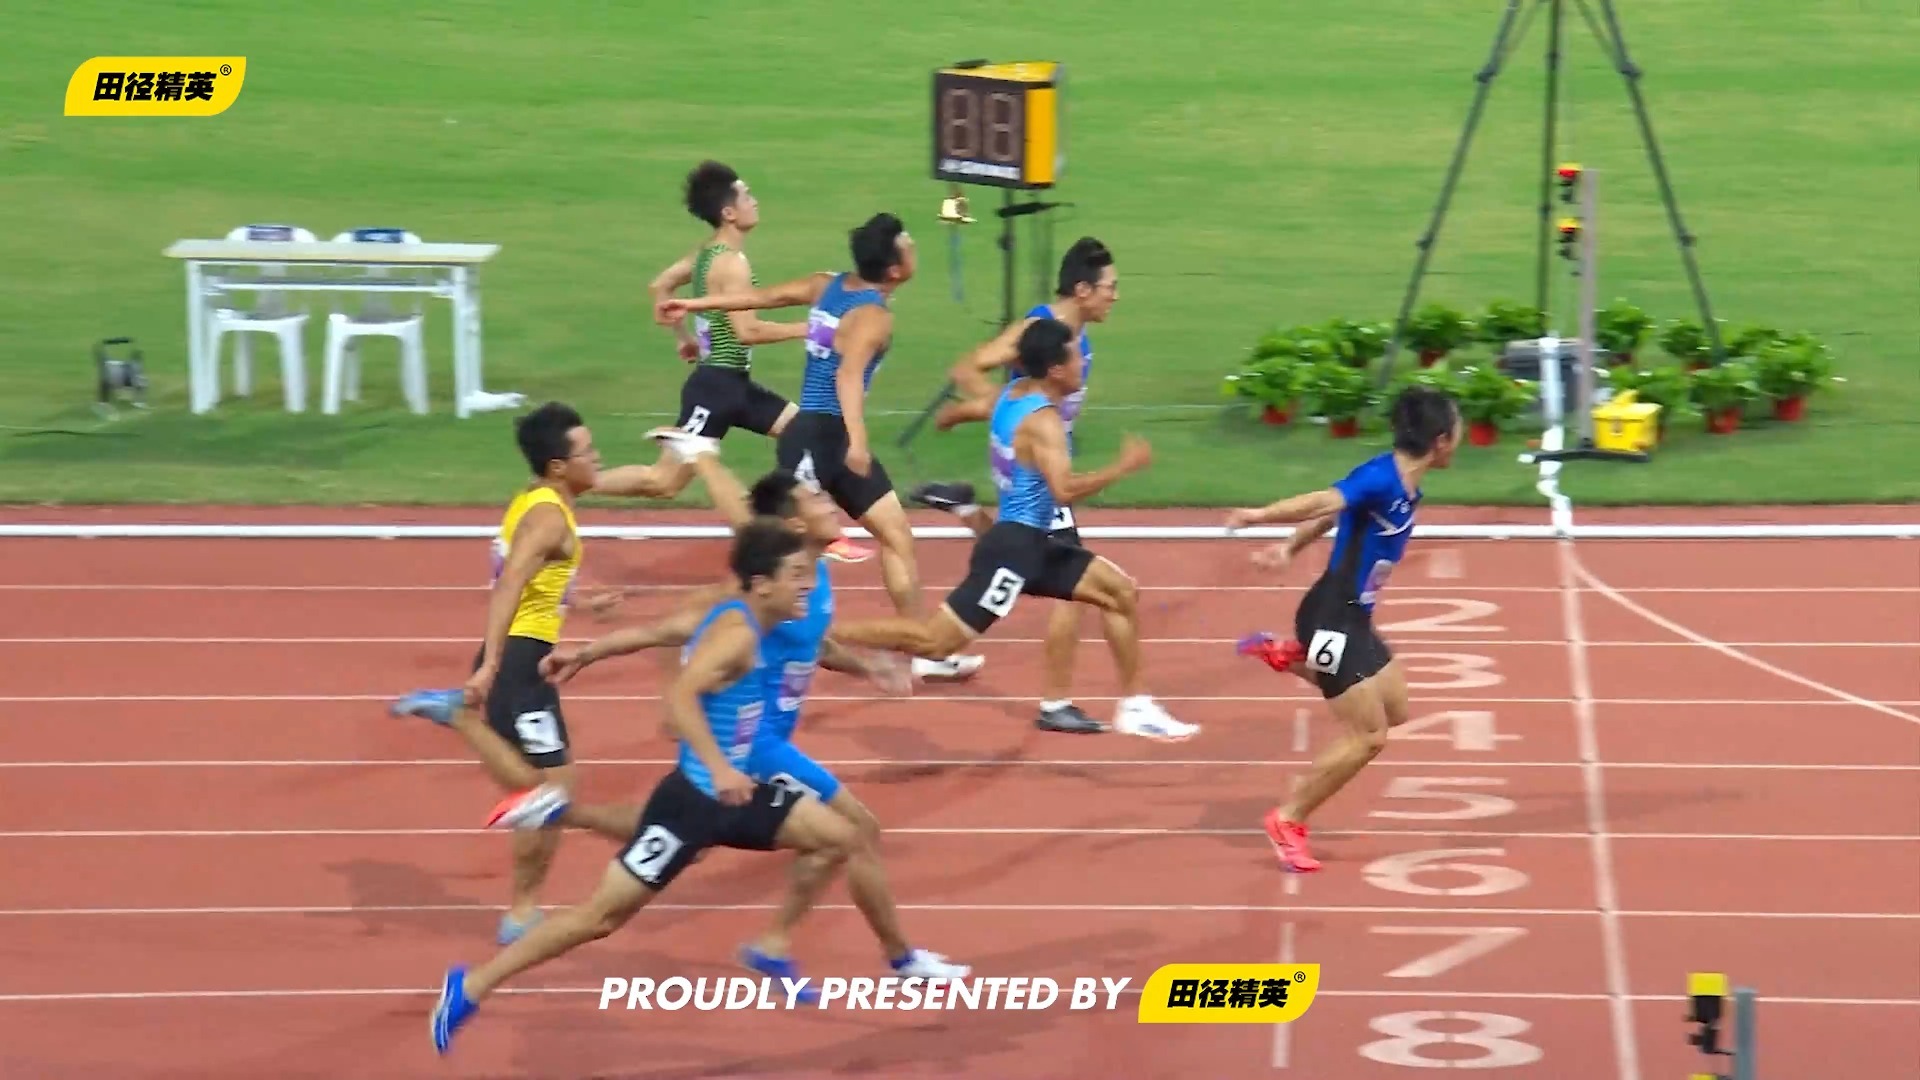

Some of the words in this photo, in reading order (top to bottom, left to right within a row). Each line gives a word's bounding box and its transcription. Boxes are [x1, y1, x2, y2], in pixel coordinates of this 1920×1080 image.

[990, 576, 1018, 606] 5
[1377, 598, 1507, 631] 2
[1315, 636, 1335, 667] 6
[1396, 653, 1505, 688] 3
[1387, 711, 1523, 750] 4
[1368, 777, 1517, 819] 5
[637, 836, 667, 865] 9
[1360, 847, 1531, 896] 6
[1368, 926, 1529, 977] 7
[1357, 1010, 1544, 1068] 8
